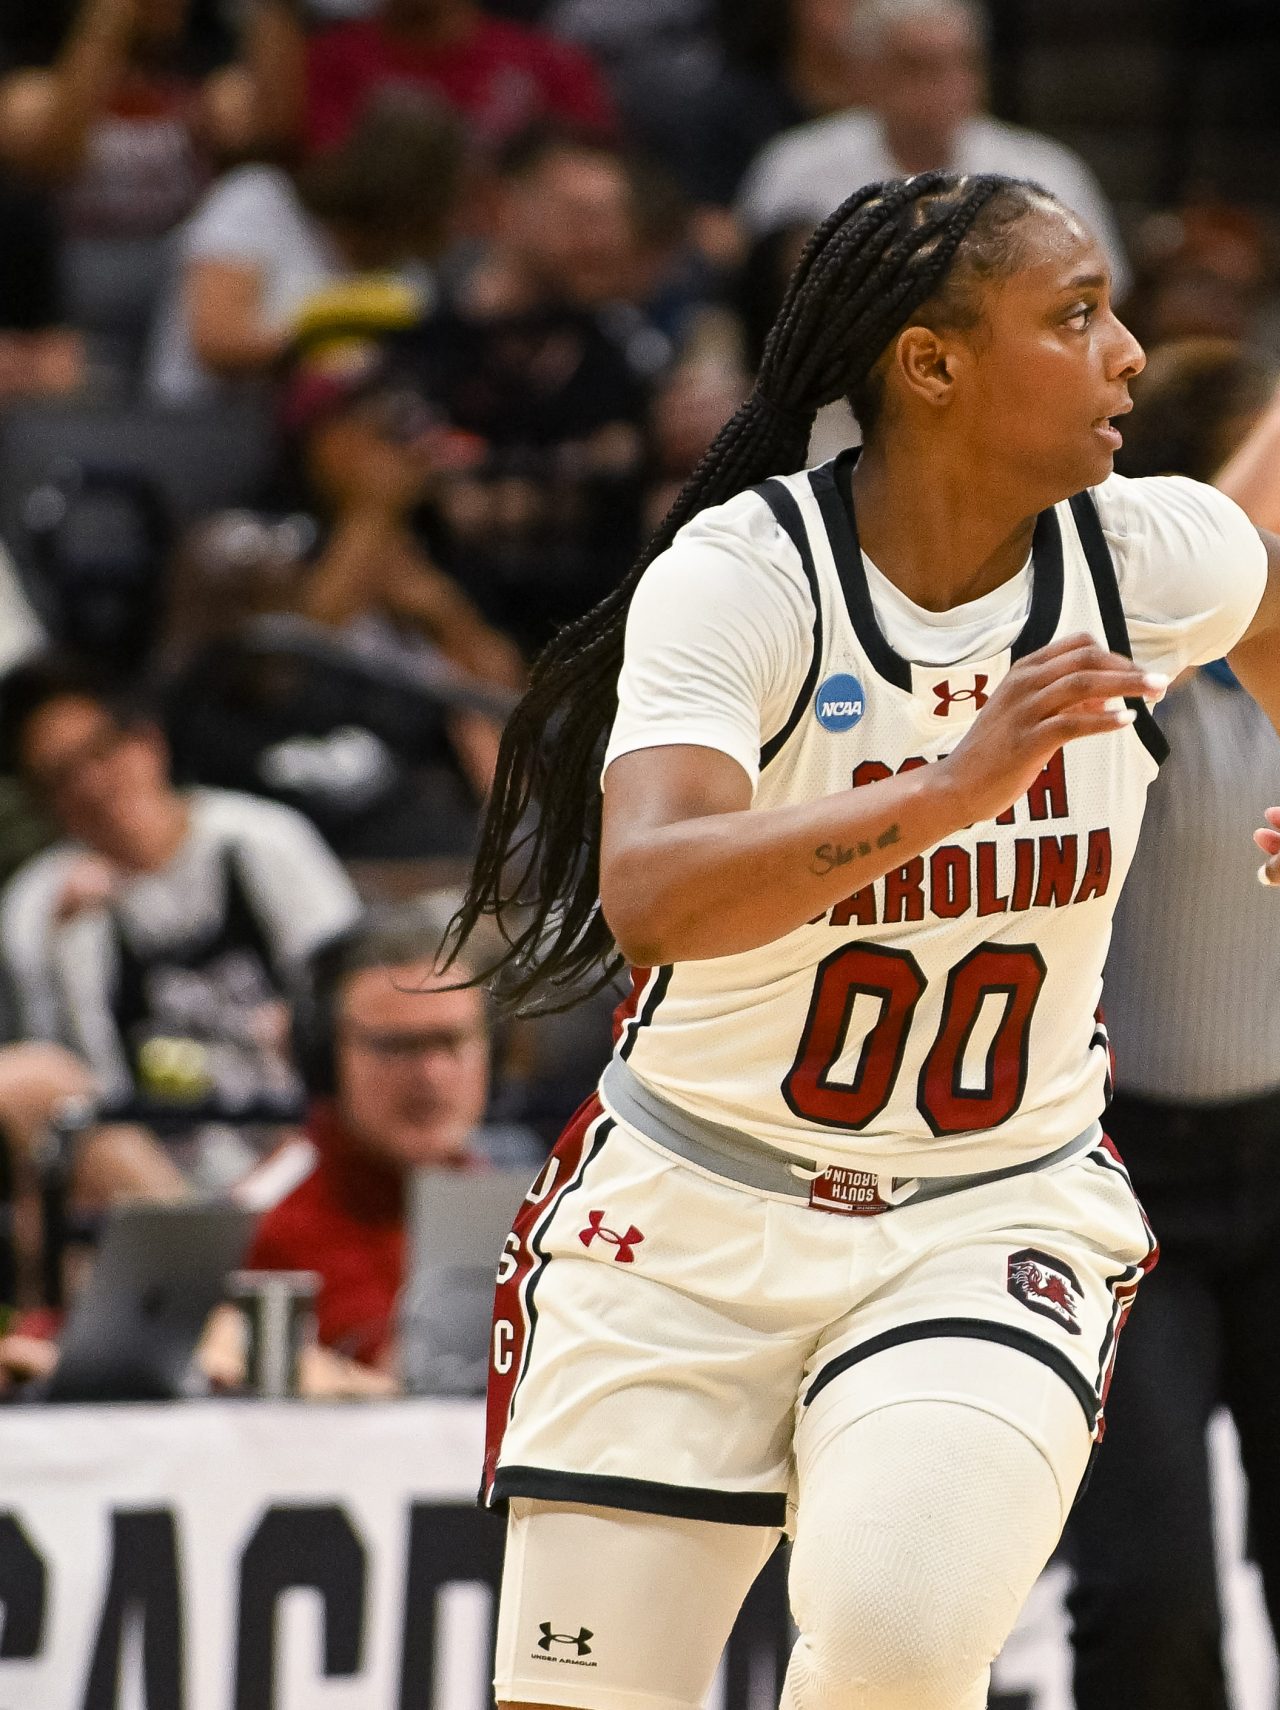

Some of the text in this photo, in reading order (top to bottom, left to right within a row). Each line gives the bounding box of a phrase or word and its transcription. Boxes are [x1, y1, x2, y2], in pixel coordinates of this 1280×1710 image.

[821, 700, 862, 717] NCAA
[806, 827, 1112, 927] AROLINA
[780, 940, 1048, 1138] 00
[824, 1168, 878, 1187] AROLINA
[832, 1183, 875, 1202] SOUTH
[531, 1653, 598, 1667] UNDER ARMOUR
